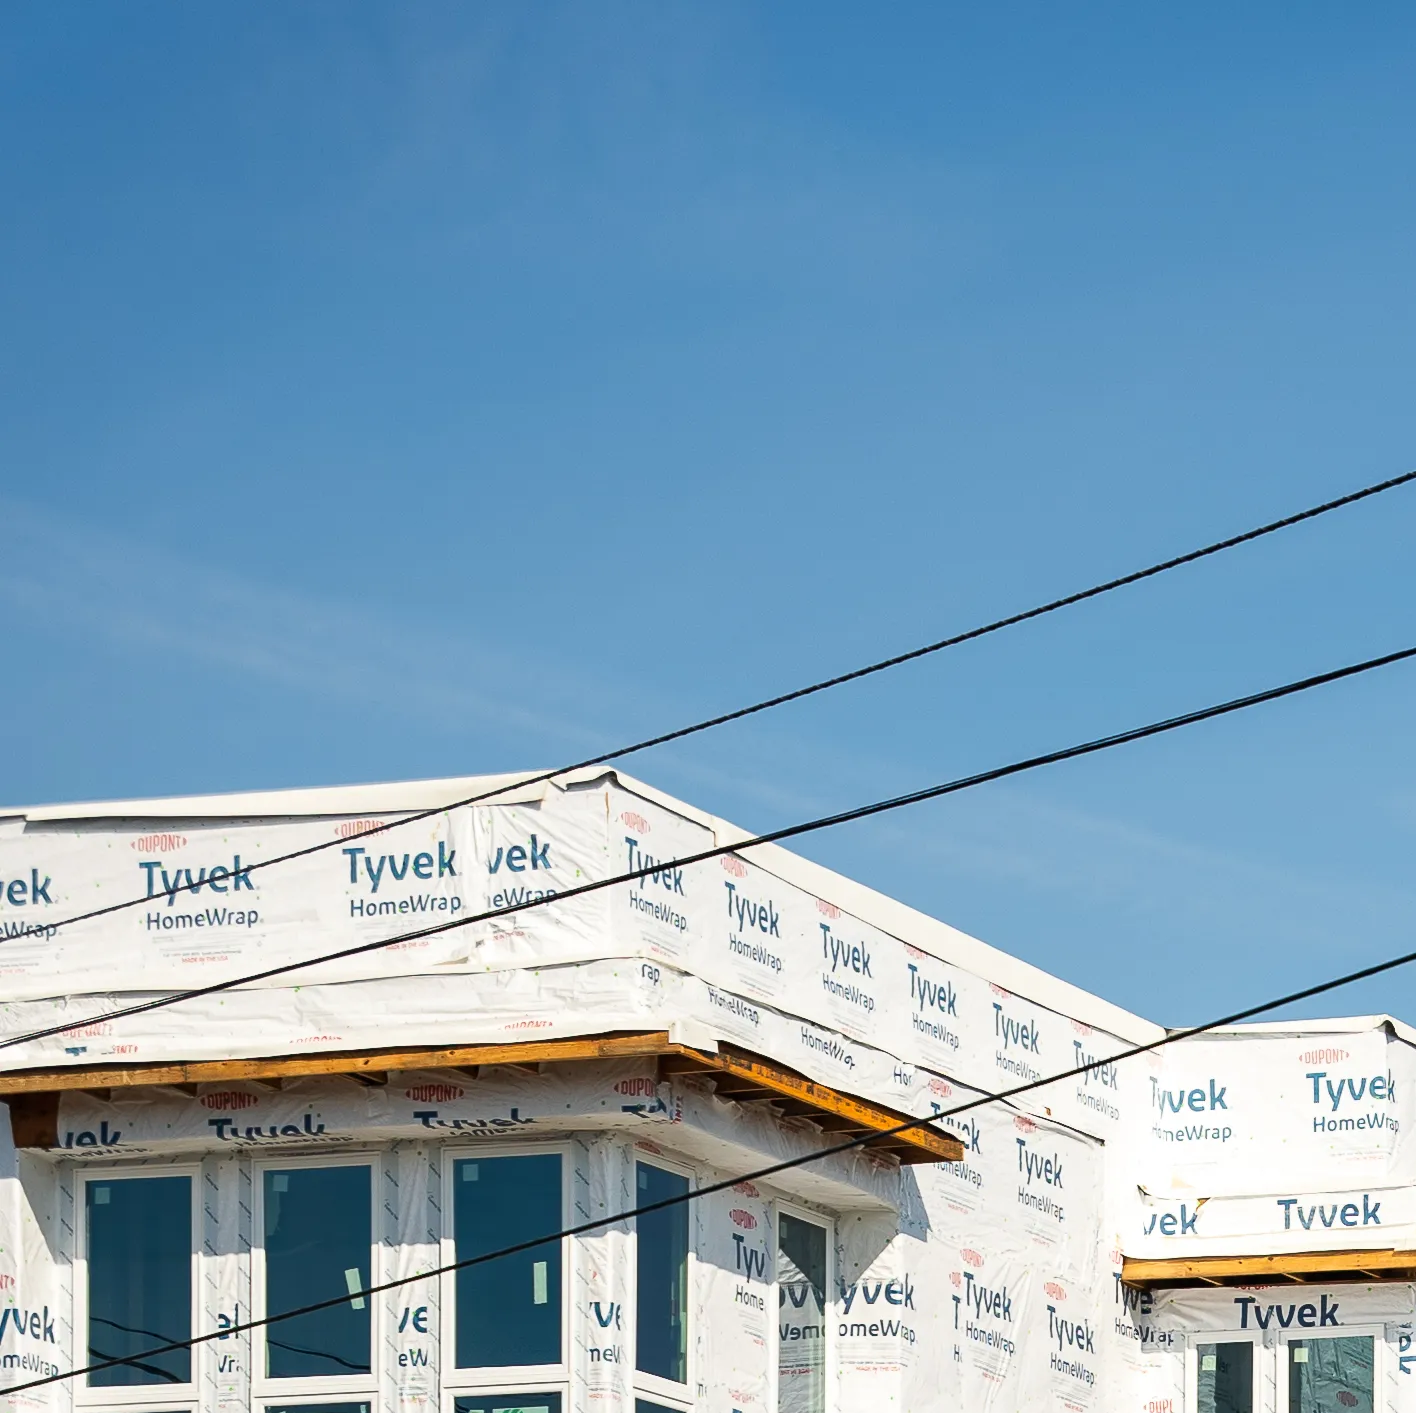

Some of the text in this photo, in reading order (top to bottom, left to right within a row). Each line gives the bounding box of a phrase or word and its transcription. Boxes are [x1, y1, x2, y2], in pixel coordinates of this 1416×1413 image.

[138, 835, 181, 852] DUPONT
[139, 855, 254, 906] Tyvek
[342, 841, 456, 893] Tyvek
[625, 836, 684, 896] Tyvek
[147, 908, 258, 930] HomeWrap
[350, 895, 461, 918] HomeWrap
[629, 890, 687, 933] HomeWrap
[725, 881, 779, 938] Tyvek
[729, 933, 782, 973] HomeWrap
[820, 923, 871, 977] Tyvek
[822, 973, 874, 1013] HomeWrap
[907, 963, 957, 1017] Tyvek
[912, 1012, 959, 1052] HomeWrap
[993, 1002, 1039, 1054] Tyvek
[996, 1051, 1042, 1083] HomeWrap
[1073, 1040, 1118, 1090] Tyvek
[1304, 1050, 1344, 1065] DUPONT
[207, 1092, 251, 1110] DUPONT
[411, 1085, 457, 1102] DUPONT
[1077, 1087, 1119, 1120] HomeWrap
[1150, 1076, 1228, 1118] Tyvek
[1306, 1069, 1395, 1112] Tyvek
[1152, 1122, 1232, 1142] HomeWrap
[1313, 1113, 1399, 1136] HomeWrap
[1016, 1138, 1063, 1188] Tyvek
[1018, 1186, 1064, 1223] HomeWrap
[735, 1284, 764, 1311] Home
[963, 1271, 1011, 1322] Tyvek
[966, 1320, 1014, 1356] HomeWrap
[1047, 1305, 1094, 1354] Tyvek
[1051, 1354, 1094, 1387] HomeWrap
